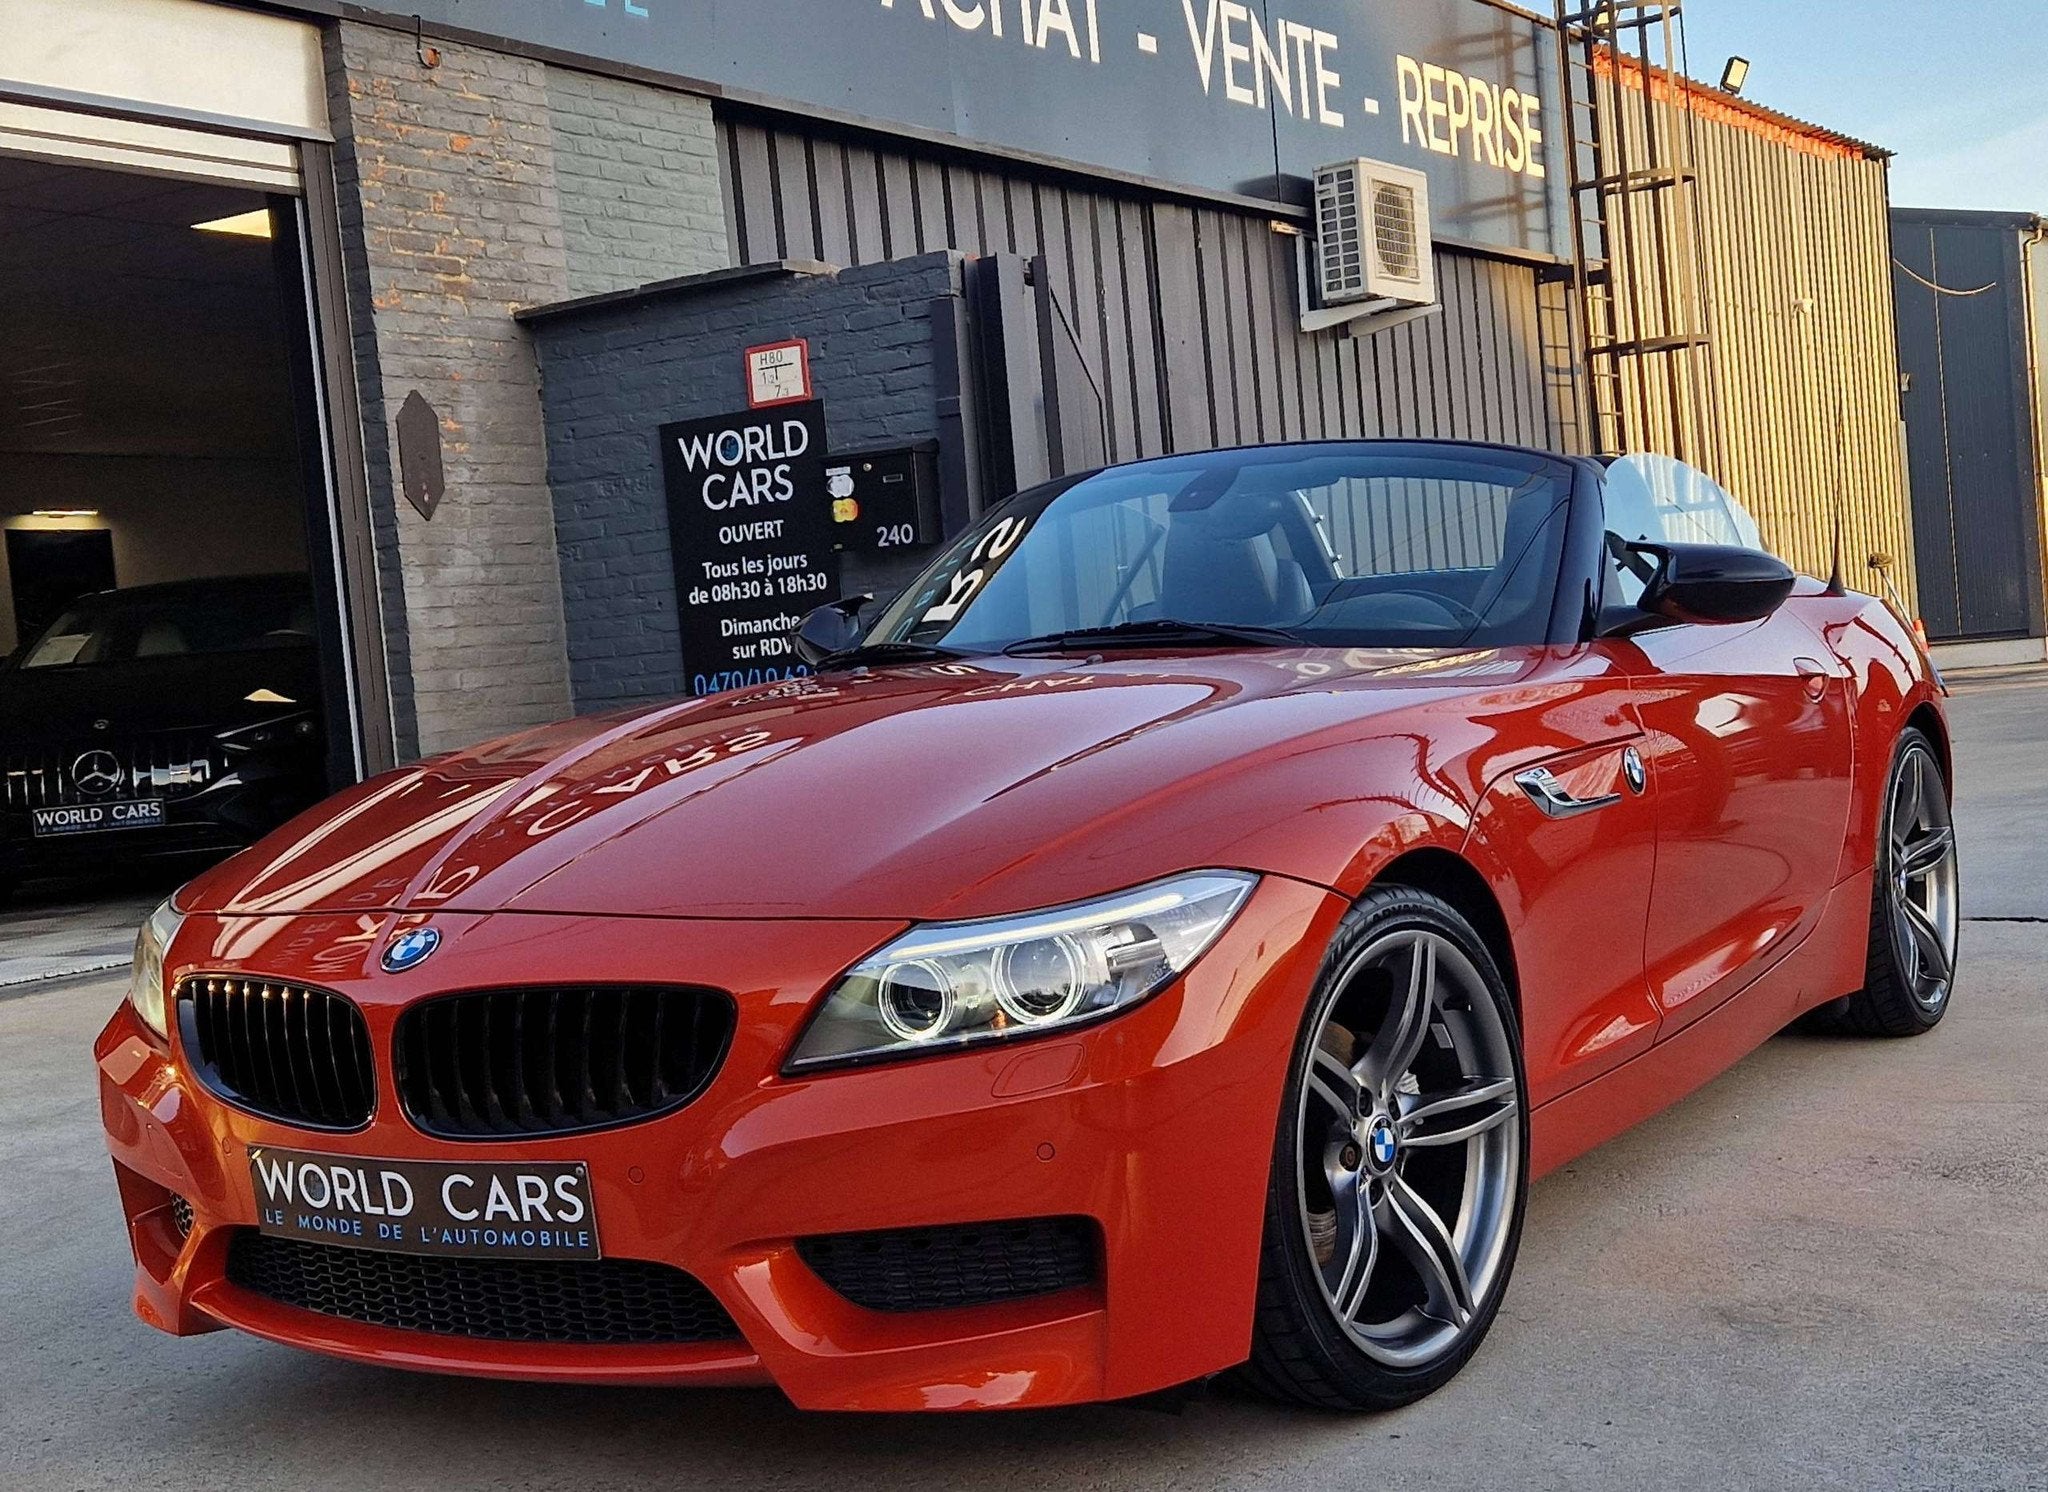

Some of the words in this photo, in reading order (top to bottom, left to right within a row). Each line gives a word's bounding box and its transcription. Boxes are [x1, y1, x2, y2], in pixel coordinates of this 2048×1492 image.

[1182, 0, 1344, 128] VENTE
[1396, 54, 1545, 178] REPRISE
[760, 350, 783, 365] H80
[678, 420, 809, 473] WORLD
[702, 464, 794, 510] CARS
[719, 520, 784, 544] OUVERT
[876, 523, 914, 547] 240
[702, 561, 739, 580] Tous
[742, 556, 764, 574] les
[767, 554, 808, 577] jours
[689, 586, 709, 605] de
[711, 580, 760, 602] 08h30
[764, 578, 774, 596] à
[778, 572, 827, 594] 18h30
[721, 612, 800, 637] Dimanche
[732, 644, 757, 659] sur
[36, 807, 103, 826] WORLD
[112, 802, 161, 819] CARS
[257, 1156, 413, 1217] WORLD
[442, 1174, 585, 1223] CARS
[265, 1208, 284, 1226] LE
[298, 1214, 363, 1236] MONDE
[379, 1225, 402, 1240] DE
[421, 1225, 589, 1248] L'AUTOMOBILE
